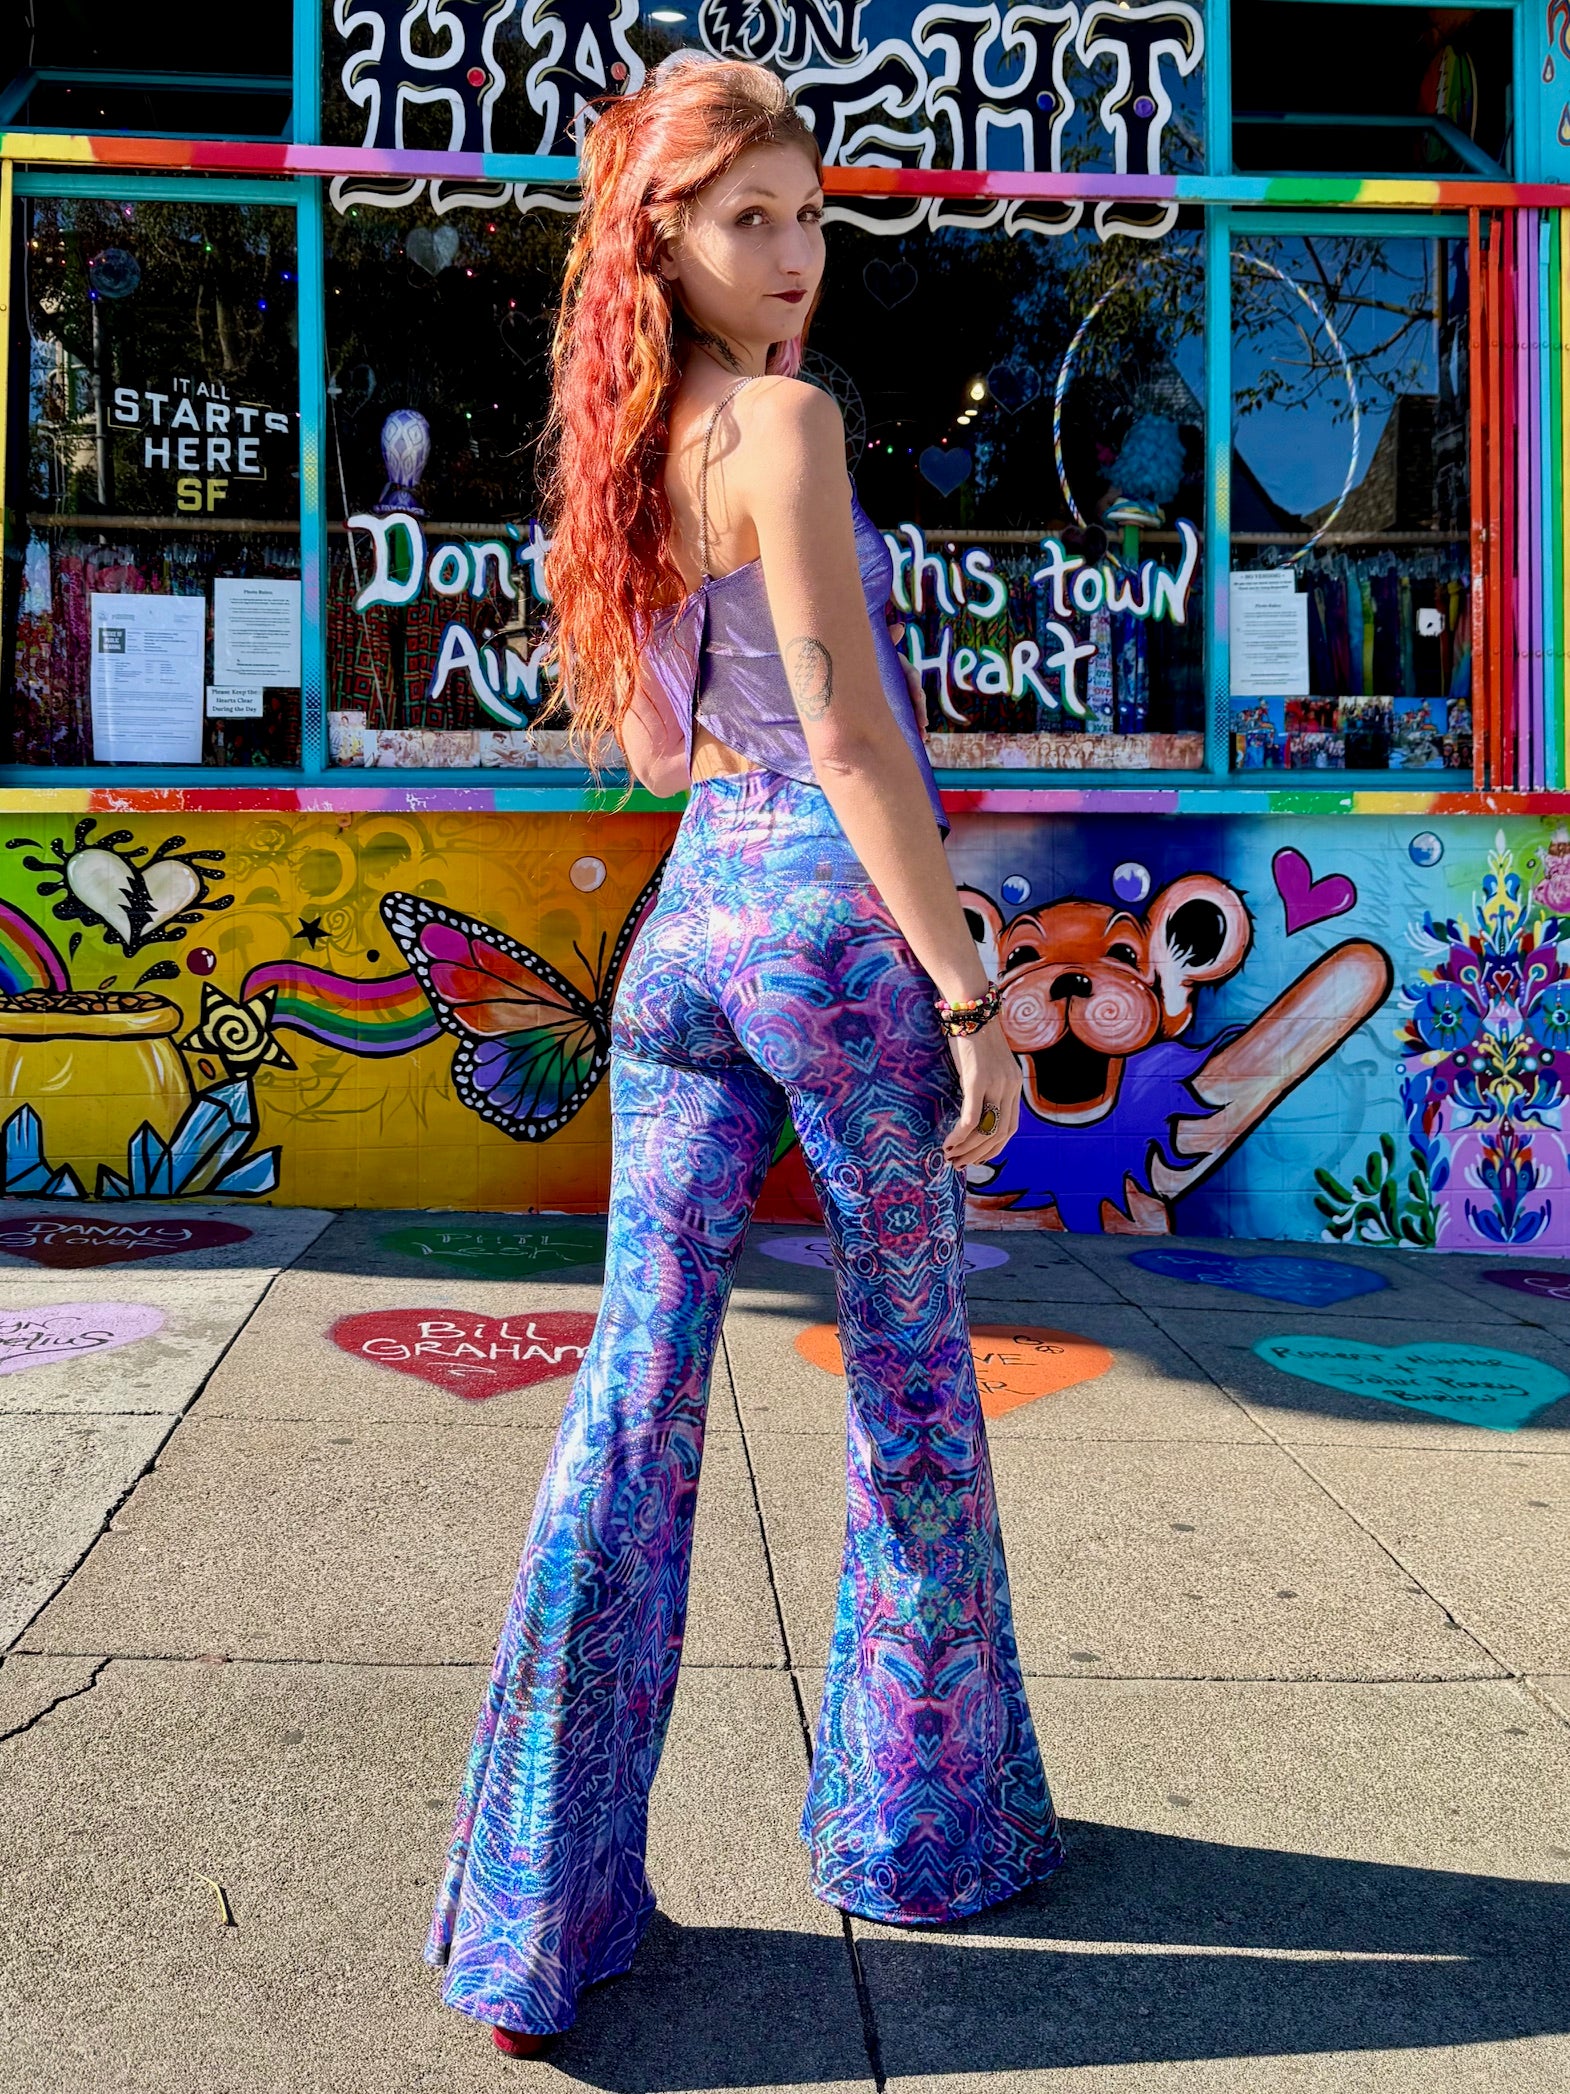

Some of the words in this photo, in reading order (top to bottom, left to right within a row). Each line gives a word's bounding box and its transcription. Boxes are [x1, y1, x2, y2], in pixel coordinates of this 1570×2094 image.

[329, 0, 1204, 242] HAGHT
[172, 377, 191, 394] IT
[196, 381, 231, 401] ALL
[114, 387, 290, 434] STARTS
[144, 437, 261, 474] HERE
[177, 477, 229, 512] SF
[344, 512, 552, 614] Don't
[231, 689, 246, 698] Keep
